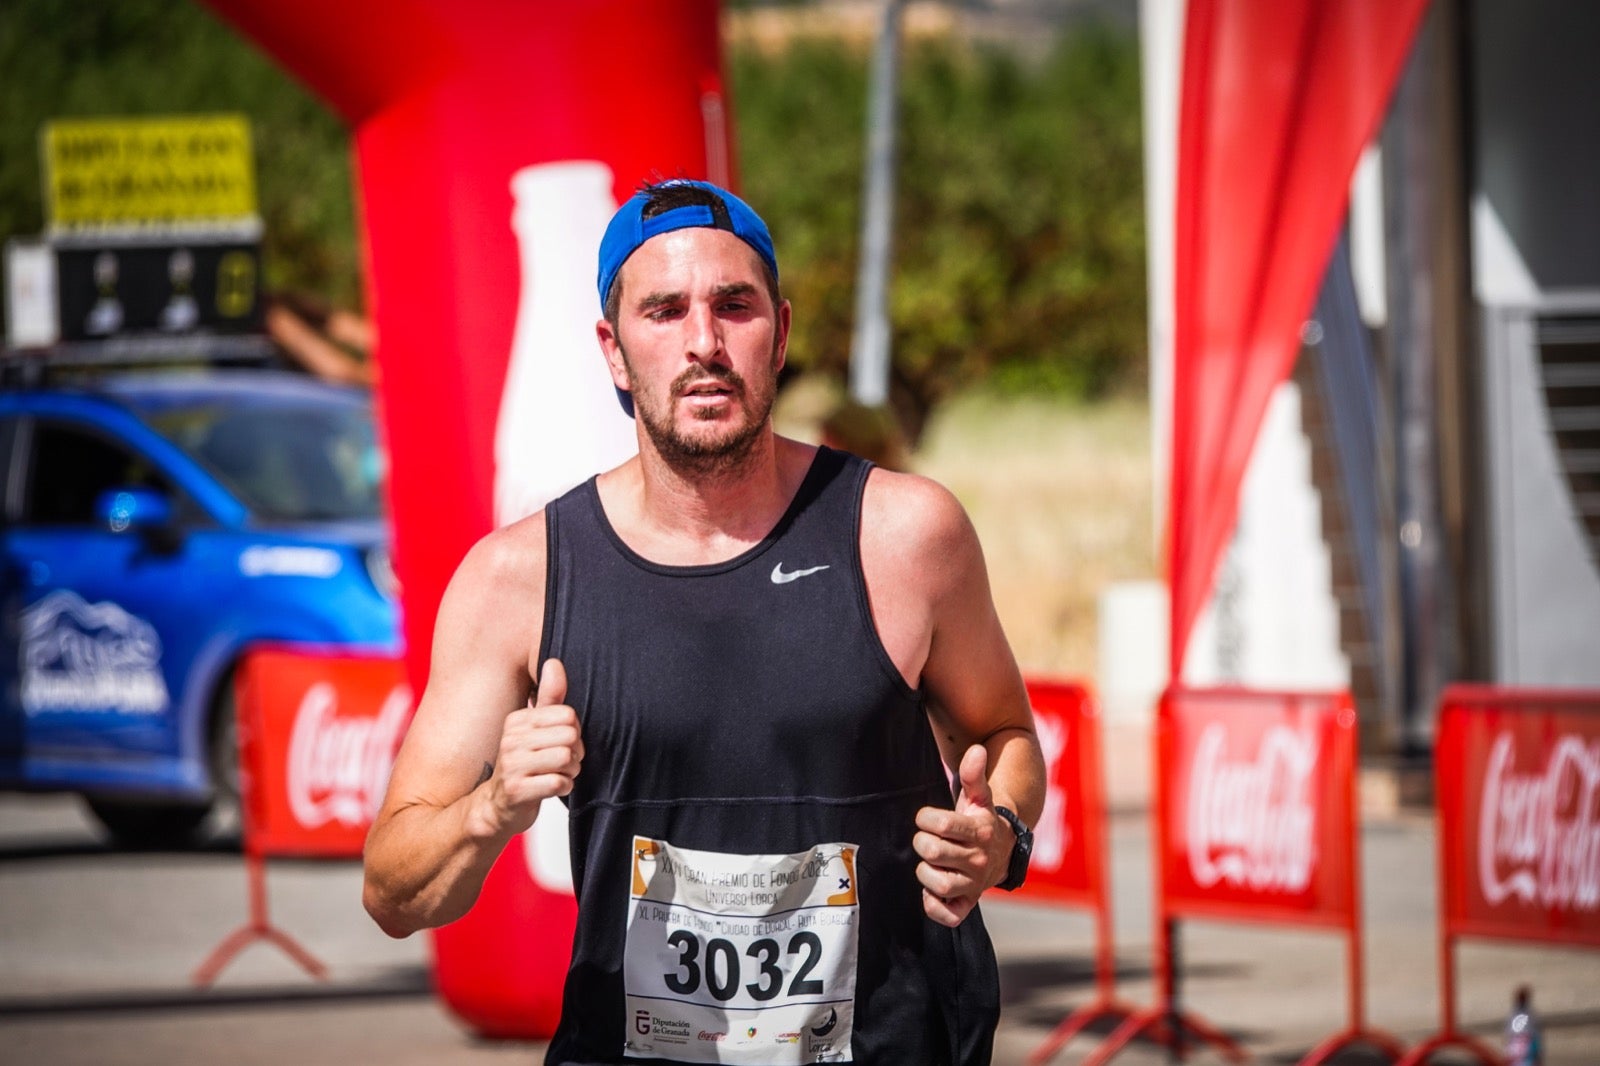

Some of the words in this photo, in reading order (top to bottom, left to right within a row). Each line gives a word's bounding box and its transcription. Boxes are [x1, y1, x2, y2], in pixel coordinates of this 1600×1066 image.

[753, 873, 766, 888] DE
[770, 869, 800, 888] FONDO
[801, 859, 830, 880] 2022
[705, 889, 748, 906] UNIVERSO
[750, 891, 778, 906] LORCA
[664, 929, 824, 1001] 3032
[652, 1017, 690, 1029] Diputación
[661, 1028, 691, 1037] Granada
